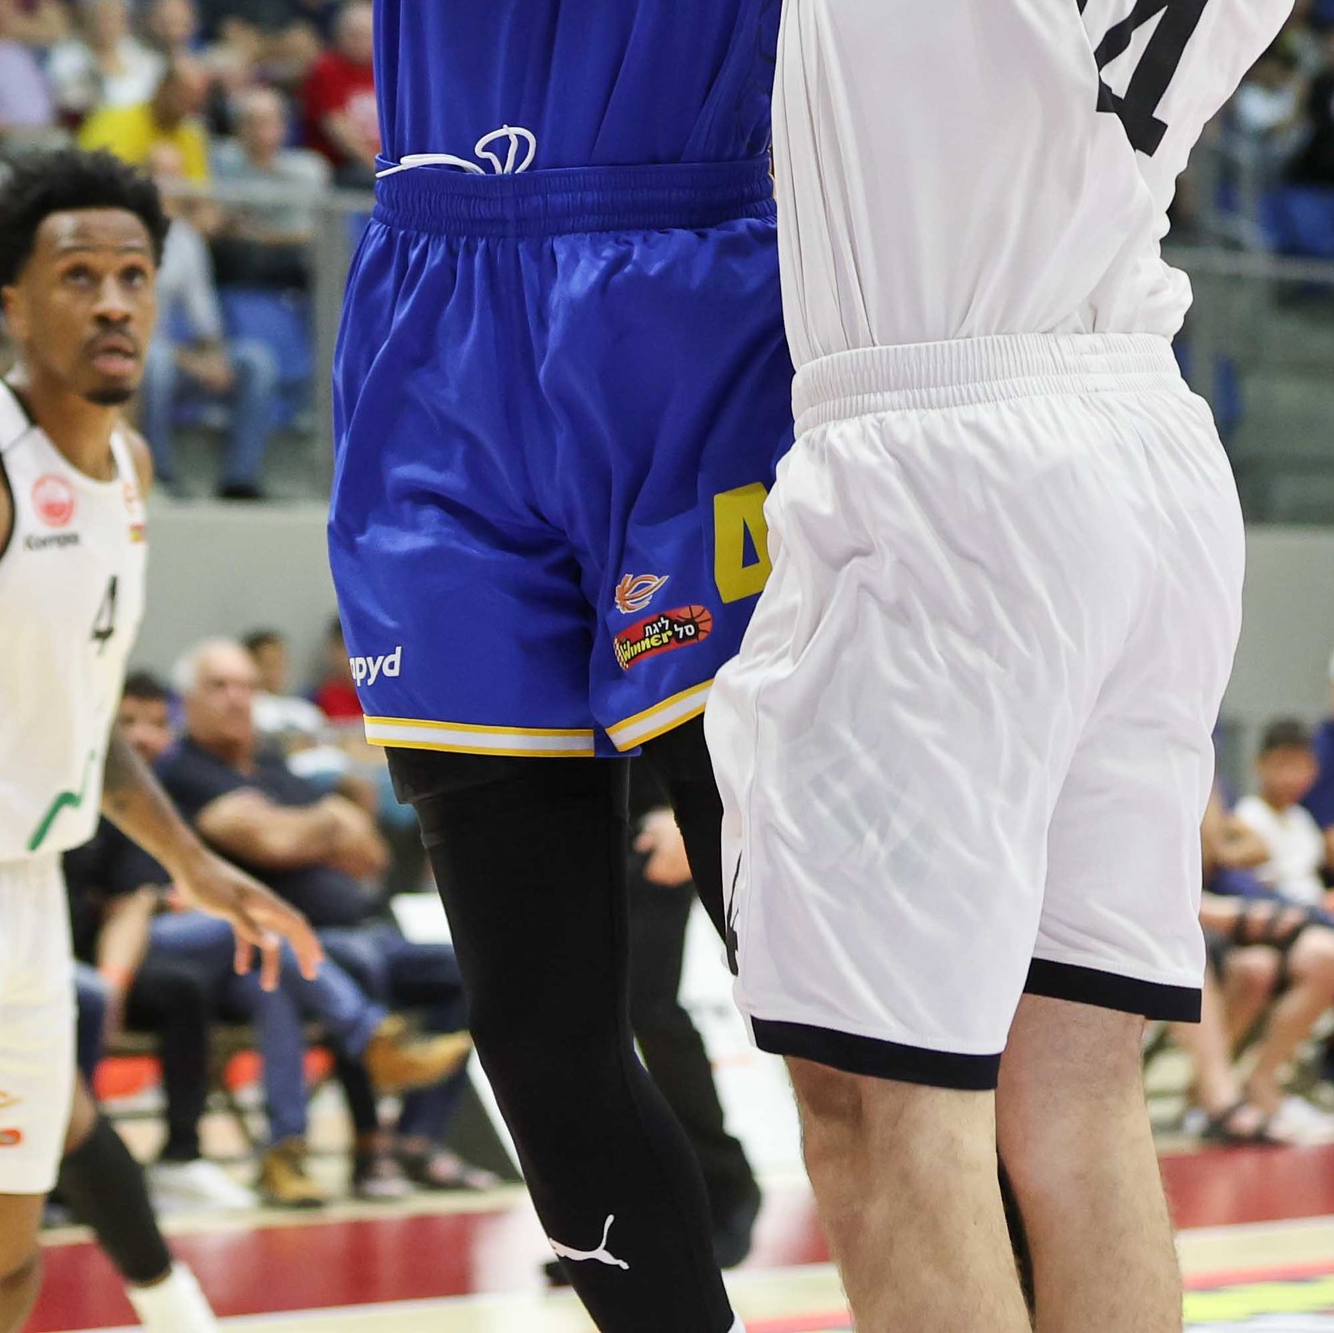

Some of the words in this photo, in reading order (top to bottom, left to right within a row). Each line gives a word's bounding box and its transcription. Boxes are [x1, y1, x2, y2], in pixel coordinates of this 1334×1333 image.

[90, 573, 118, 656] 4
[620, 630, 673, 662] Winner
[674, 624, 695, 639] סל
